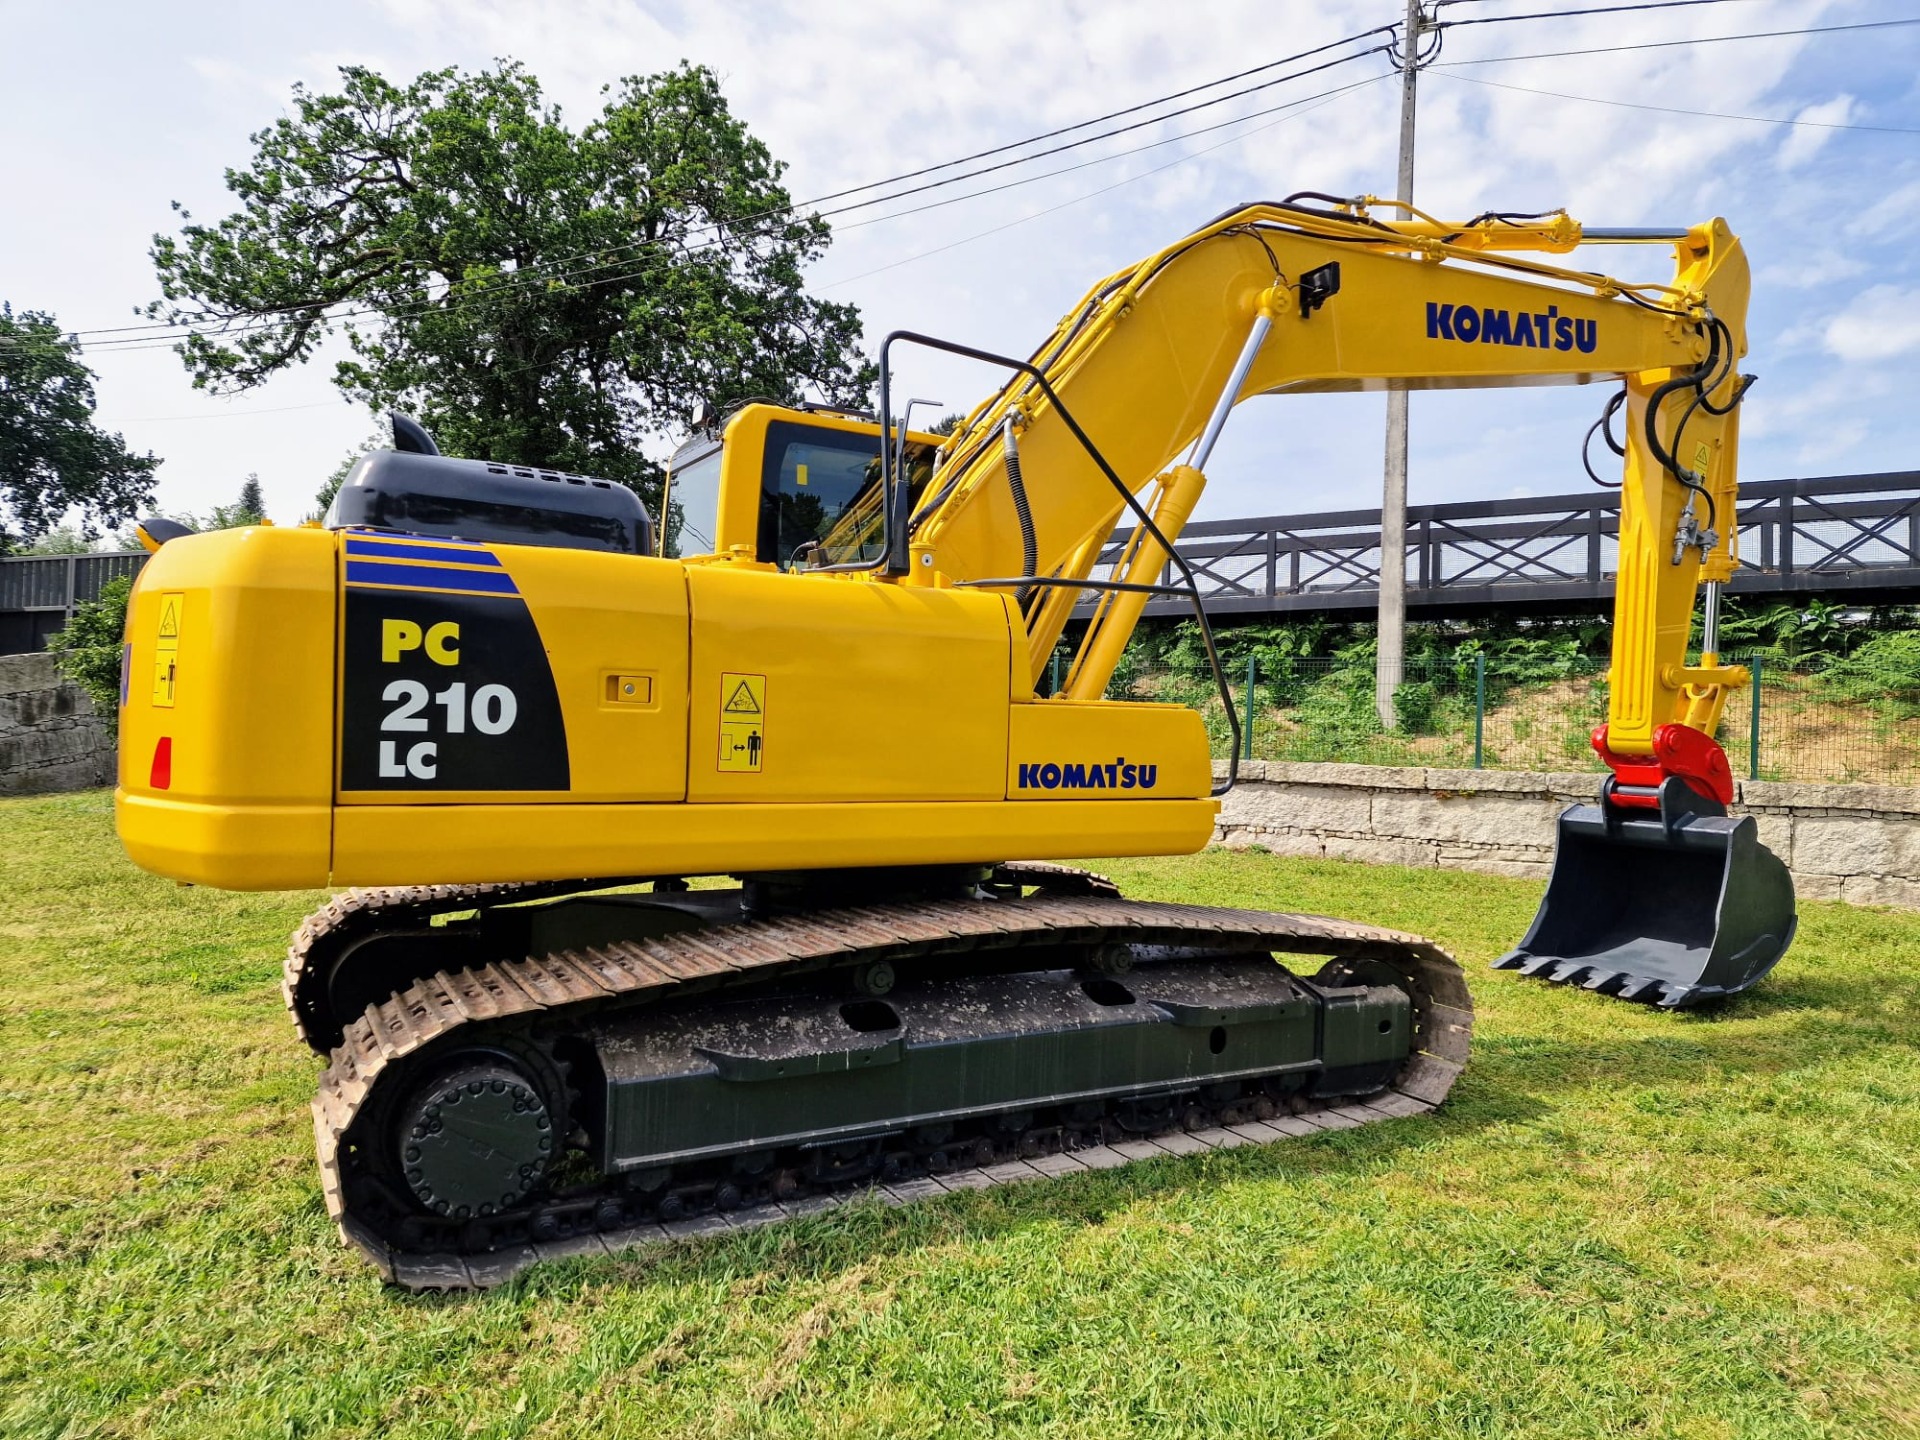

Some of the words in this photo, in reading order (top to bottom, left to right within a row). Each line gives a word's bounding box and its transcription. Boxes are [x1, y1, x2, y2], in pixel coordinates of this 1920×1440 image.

[1427, 302, 1597, 353] KOMATSU
[382, 619, 460, 665] PC
[380, 680, 517, 734] 210
[379, 741, 437, 779] LC
[1019, 757, 1157, 789] KOMATSU
